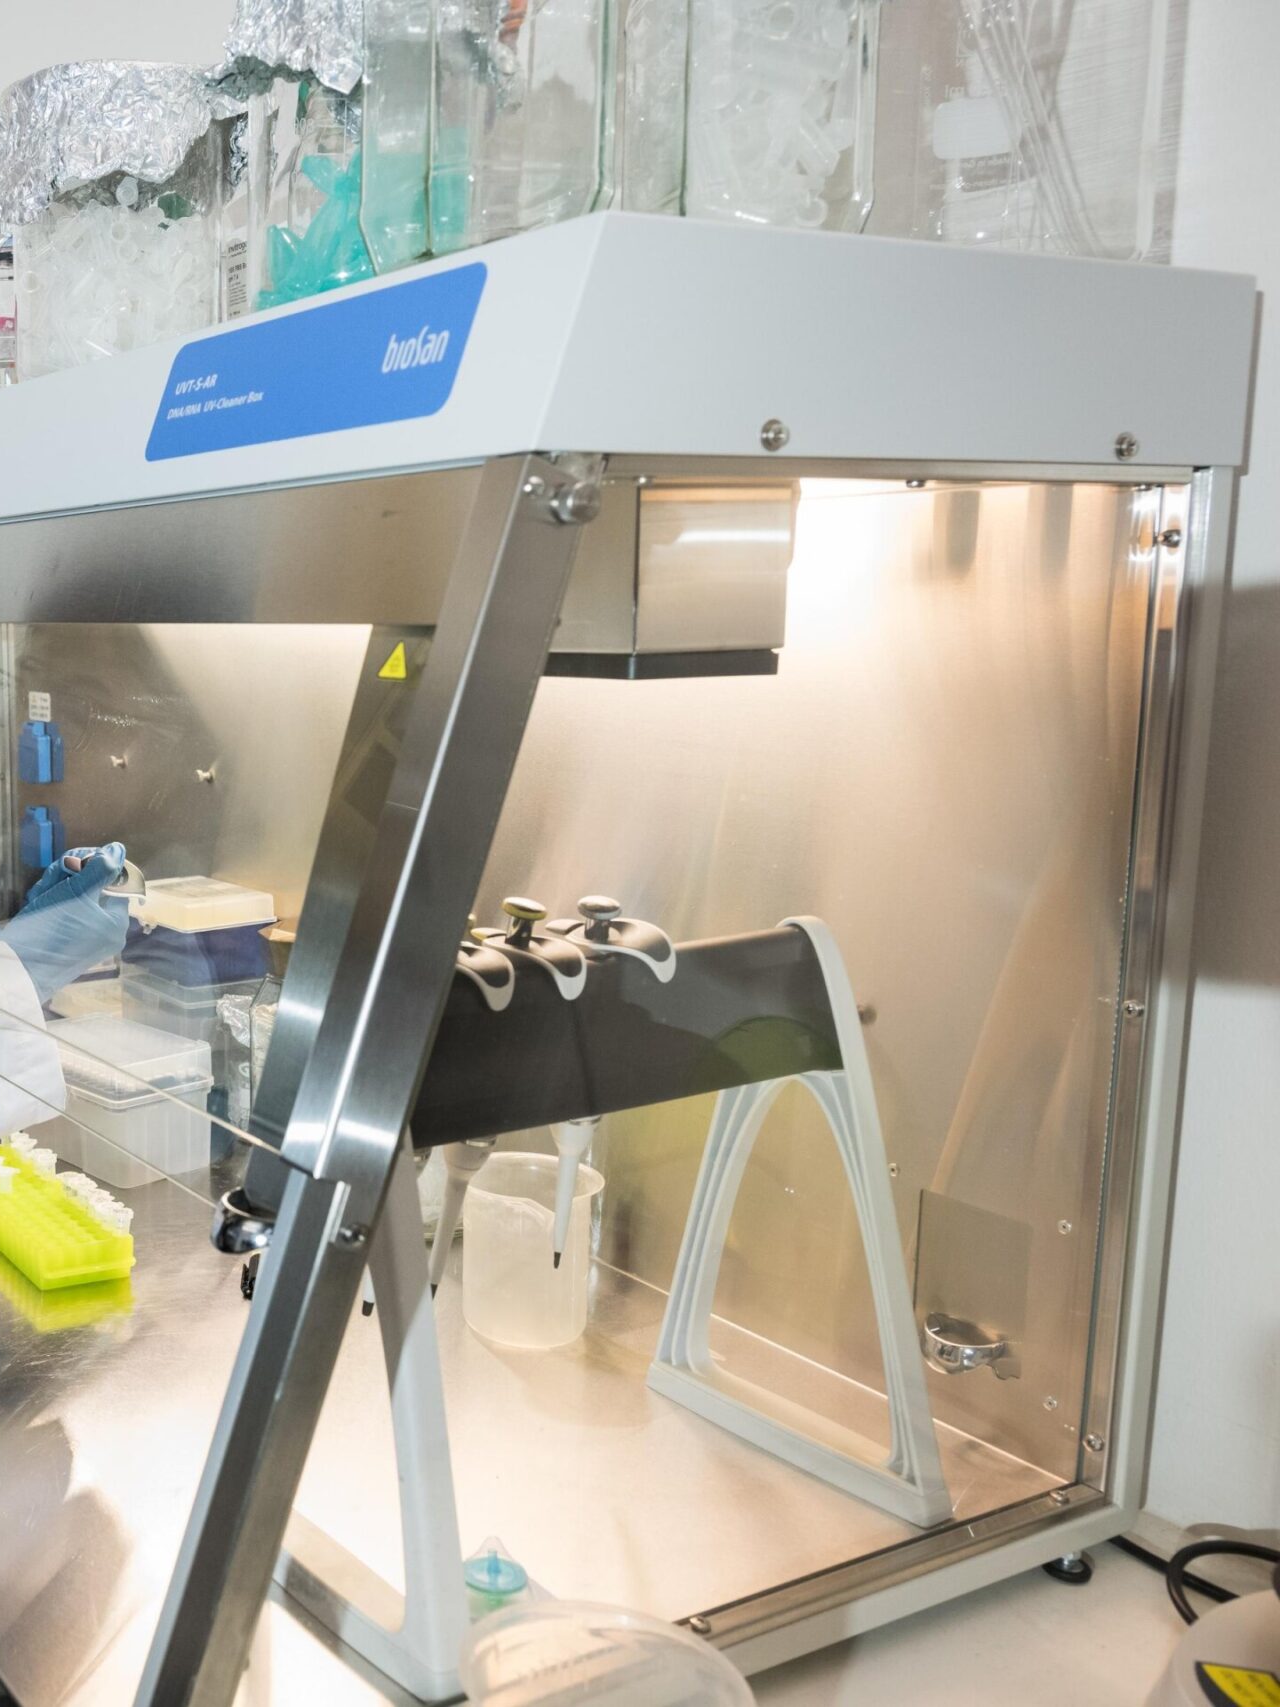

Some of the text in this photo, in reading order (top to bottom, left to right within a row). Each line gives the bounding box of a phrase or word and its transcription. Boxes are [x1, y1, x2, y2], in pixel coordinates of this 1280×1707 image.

[175, 373, 218, 396] UVT-S-AR
[166, 391, 264, 420] DNA/RNA UV-Cleaner Box
